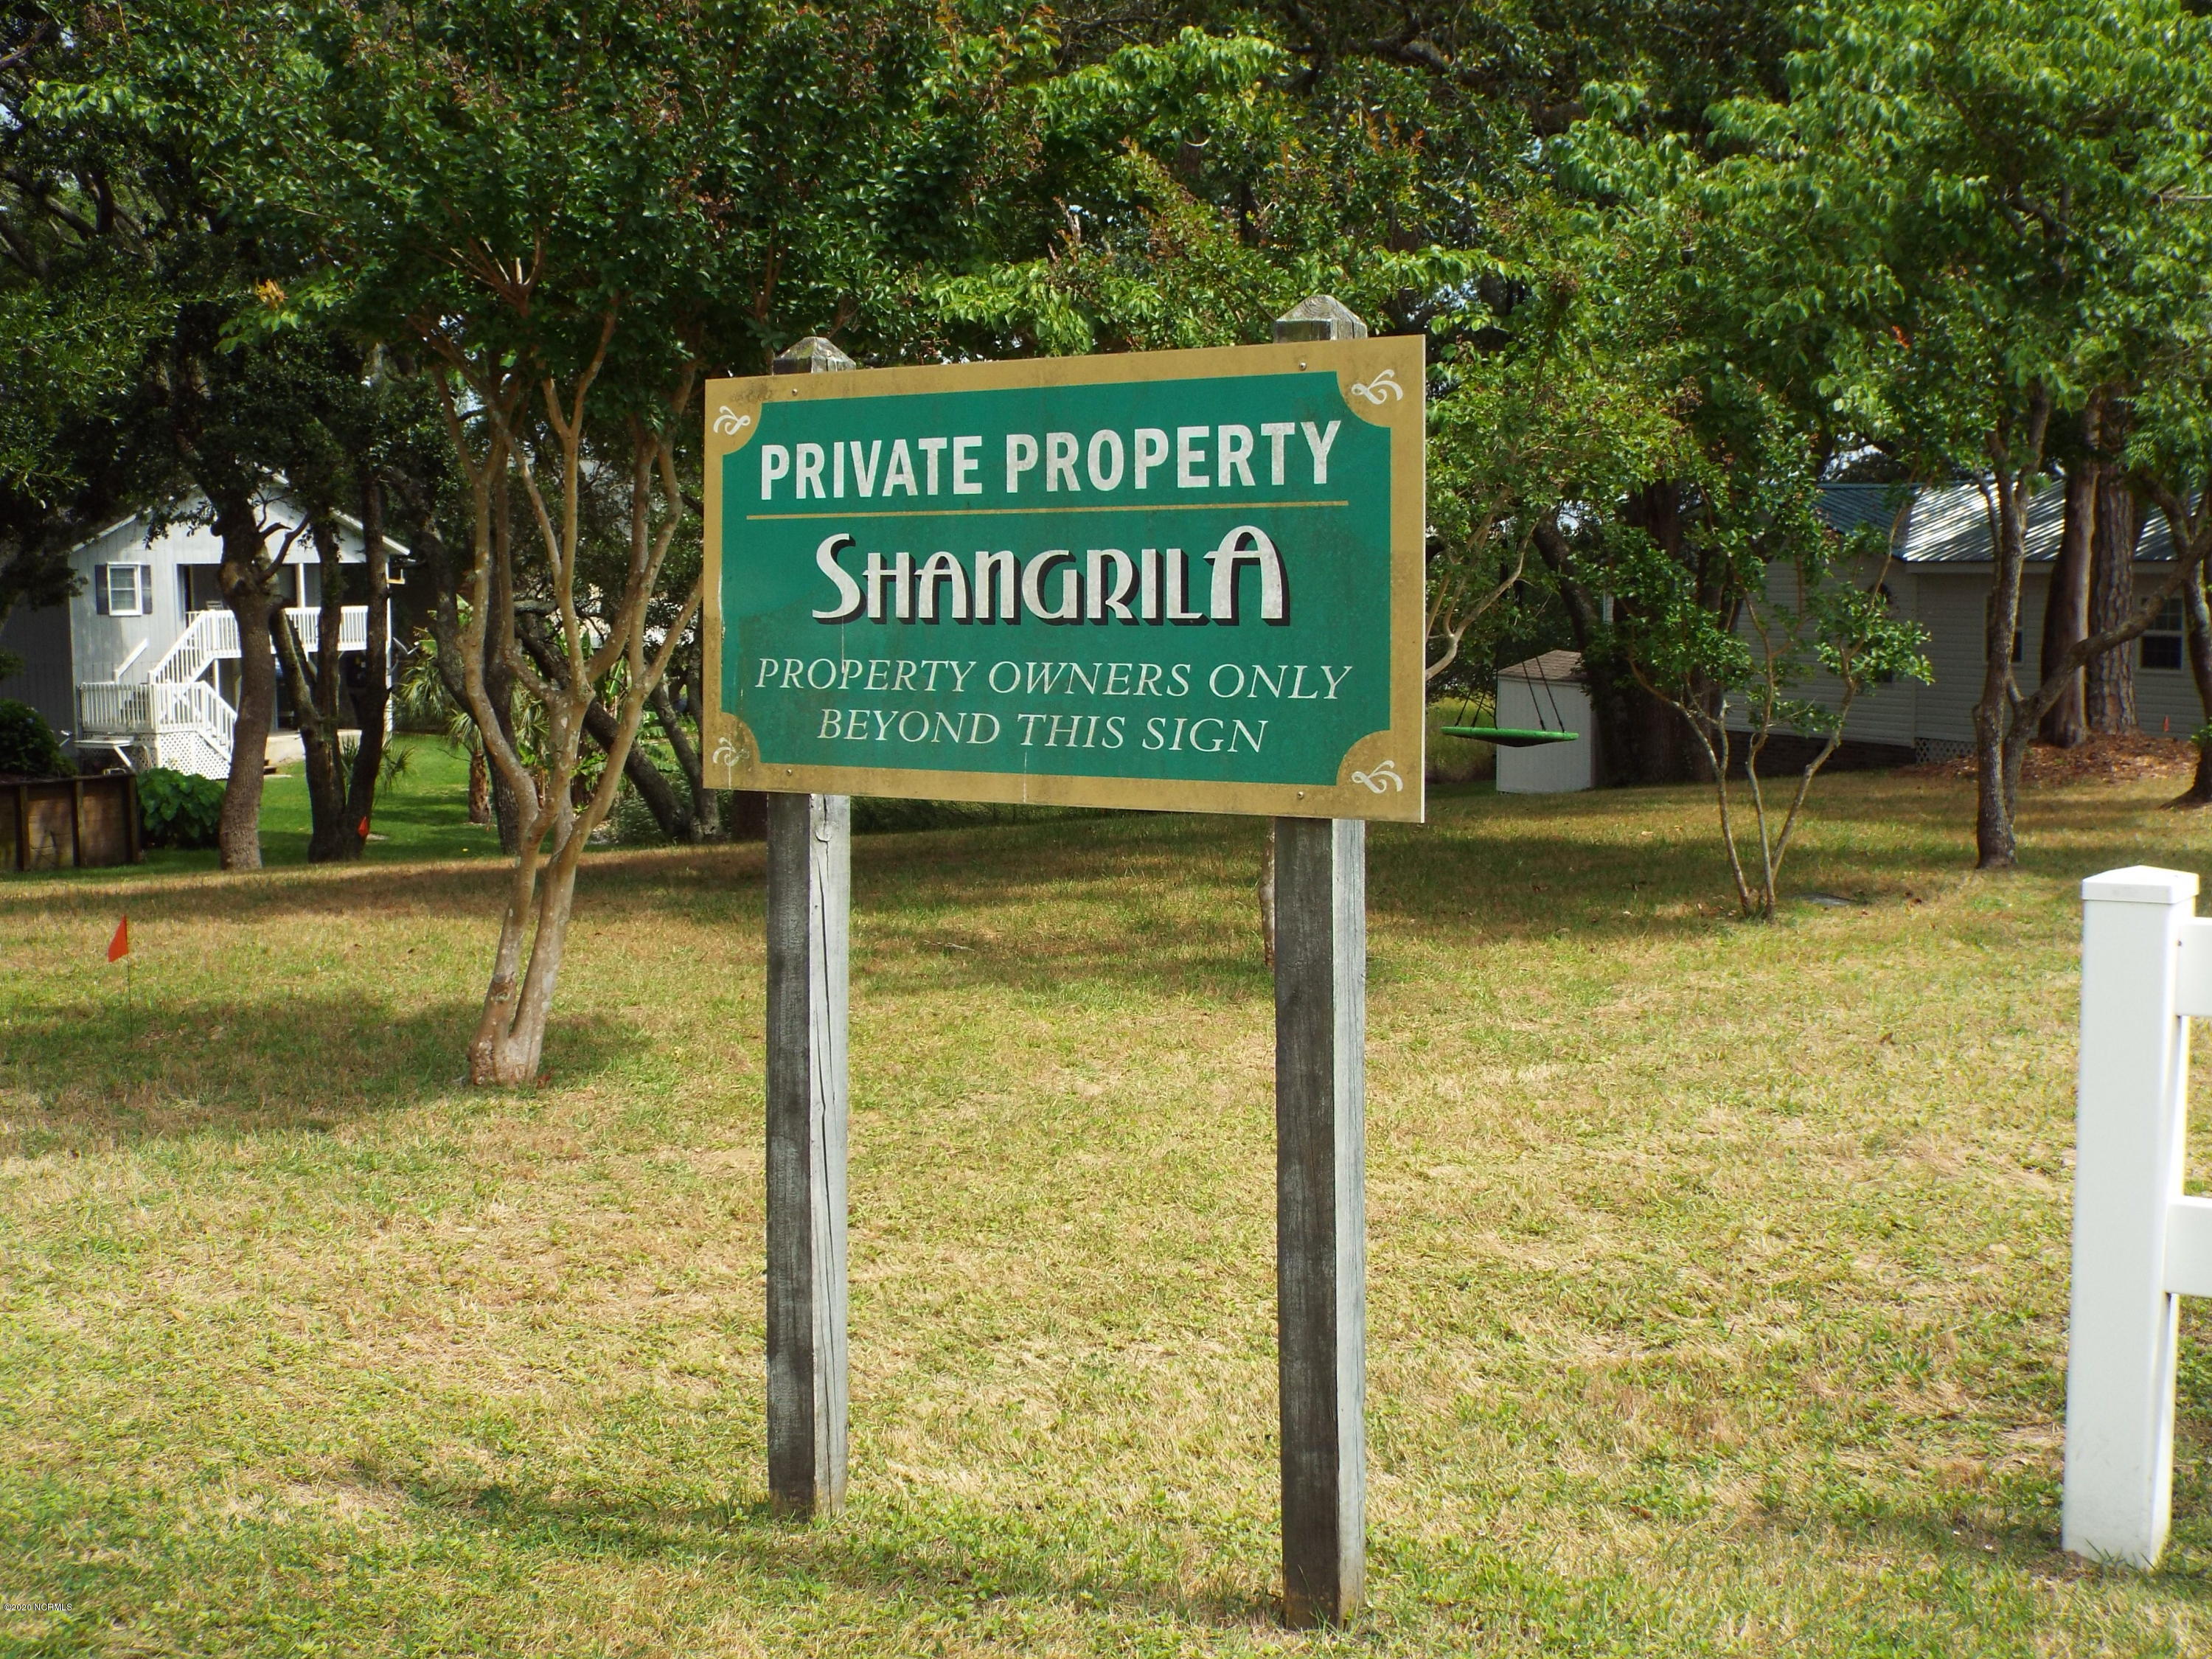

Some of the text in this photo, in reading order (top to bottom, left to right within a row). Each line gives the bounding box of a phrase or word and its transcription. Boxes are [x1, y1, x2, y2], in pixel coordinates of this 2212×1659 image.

[760, 420, 1342, 501] PRIVATE PROPERTY
[754, 656, 1354, 700] PROPERTY OWNERS ONLY
[818, 709, 1269, 754] BEYOND THIS SIGN
